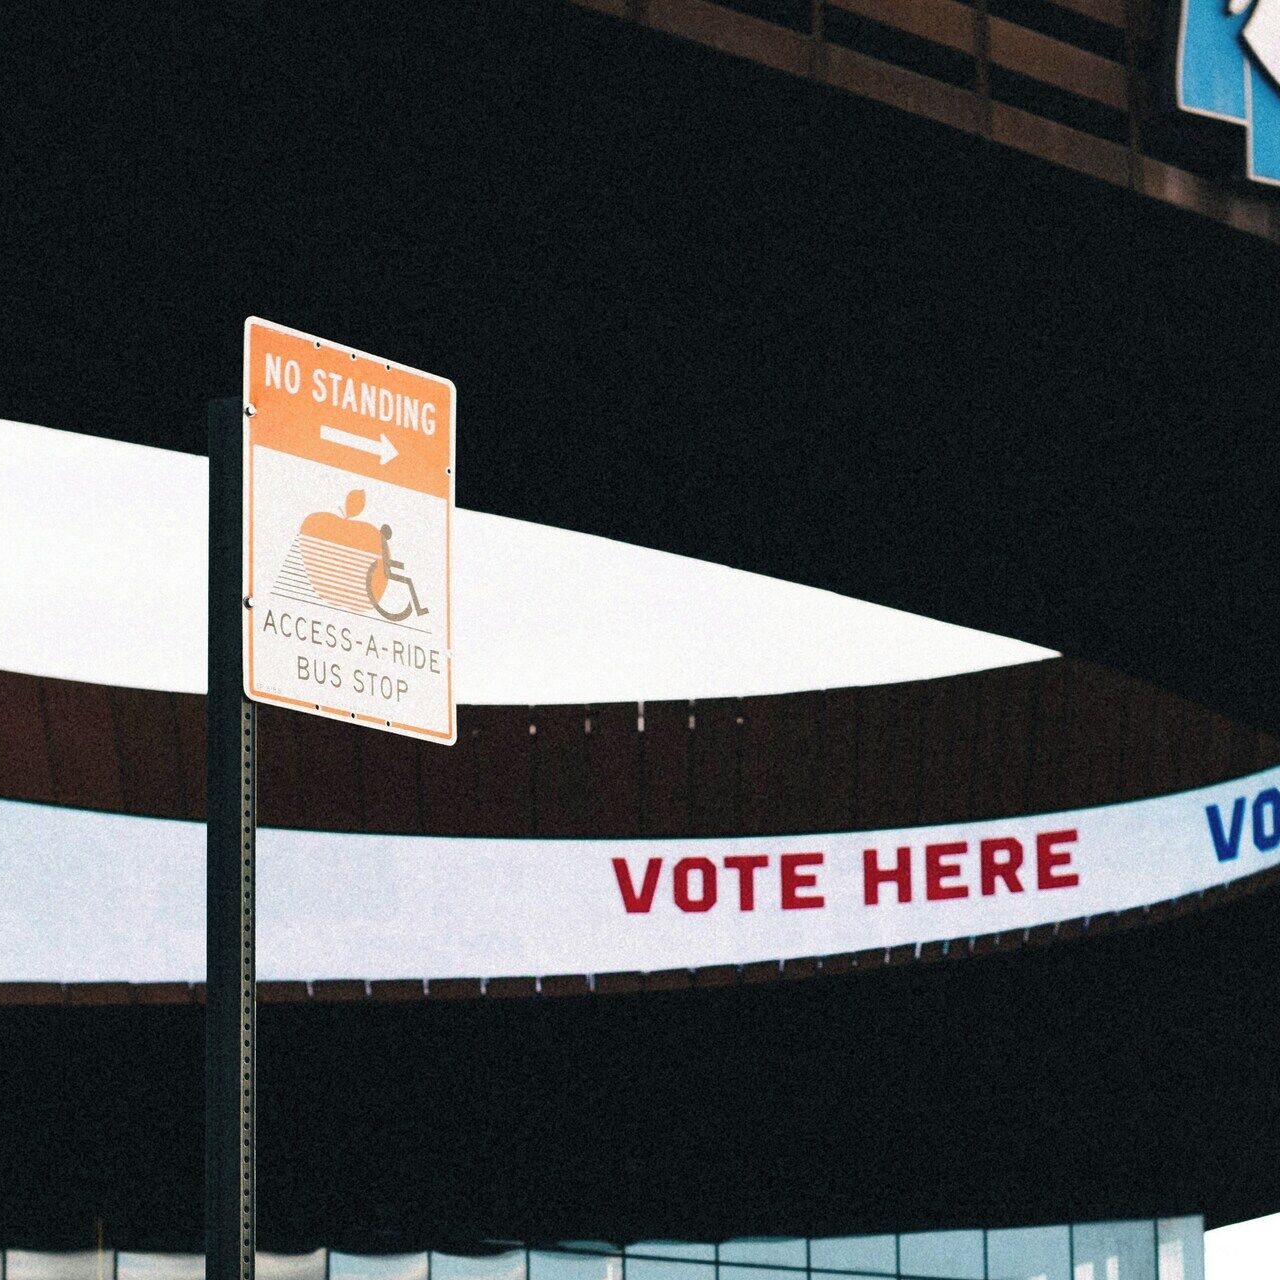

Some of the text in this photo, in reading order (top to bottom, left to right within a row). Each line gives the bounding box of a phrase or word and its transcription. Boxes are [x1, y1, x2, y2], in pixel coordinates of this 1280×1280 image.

[264, 352, 436, 436] NO STANDING
[263, 609, 441, 675] ACCESS-A-RIDE
[297, 655, 342, 689] BUS
[353, 669, 409, 702] STOP
[612, 828, 1080, 914] VOTE HERE
